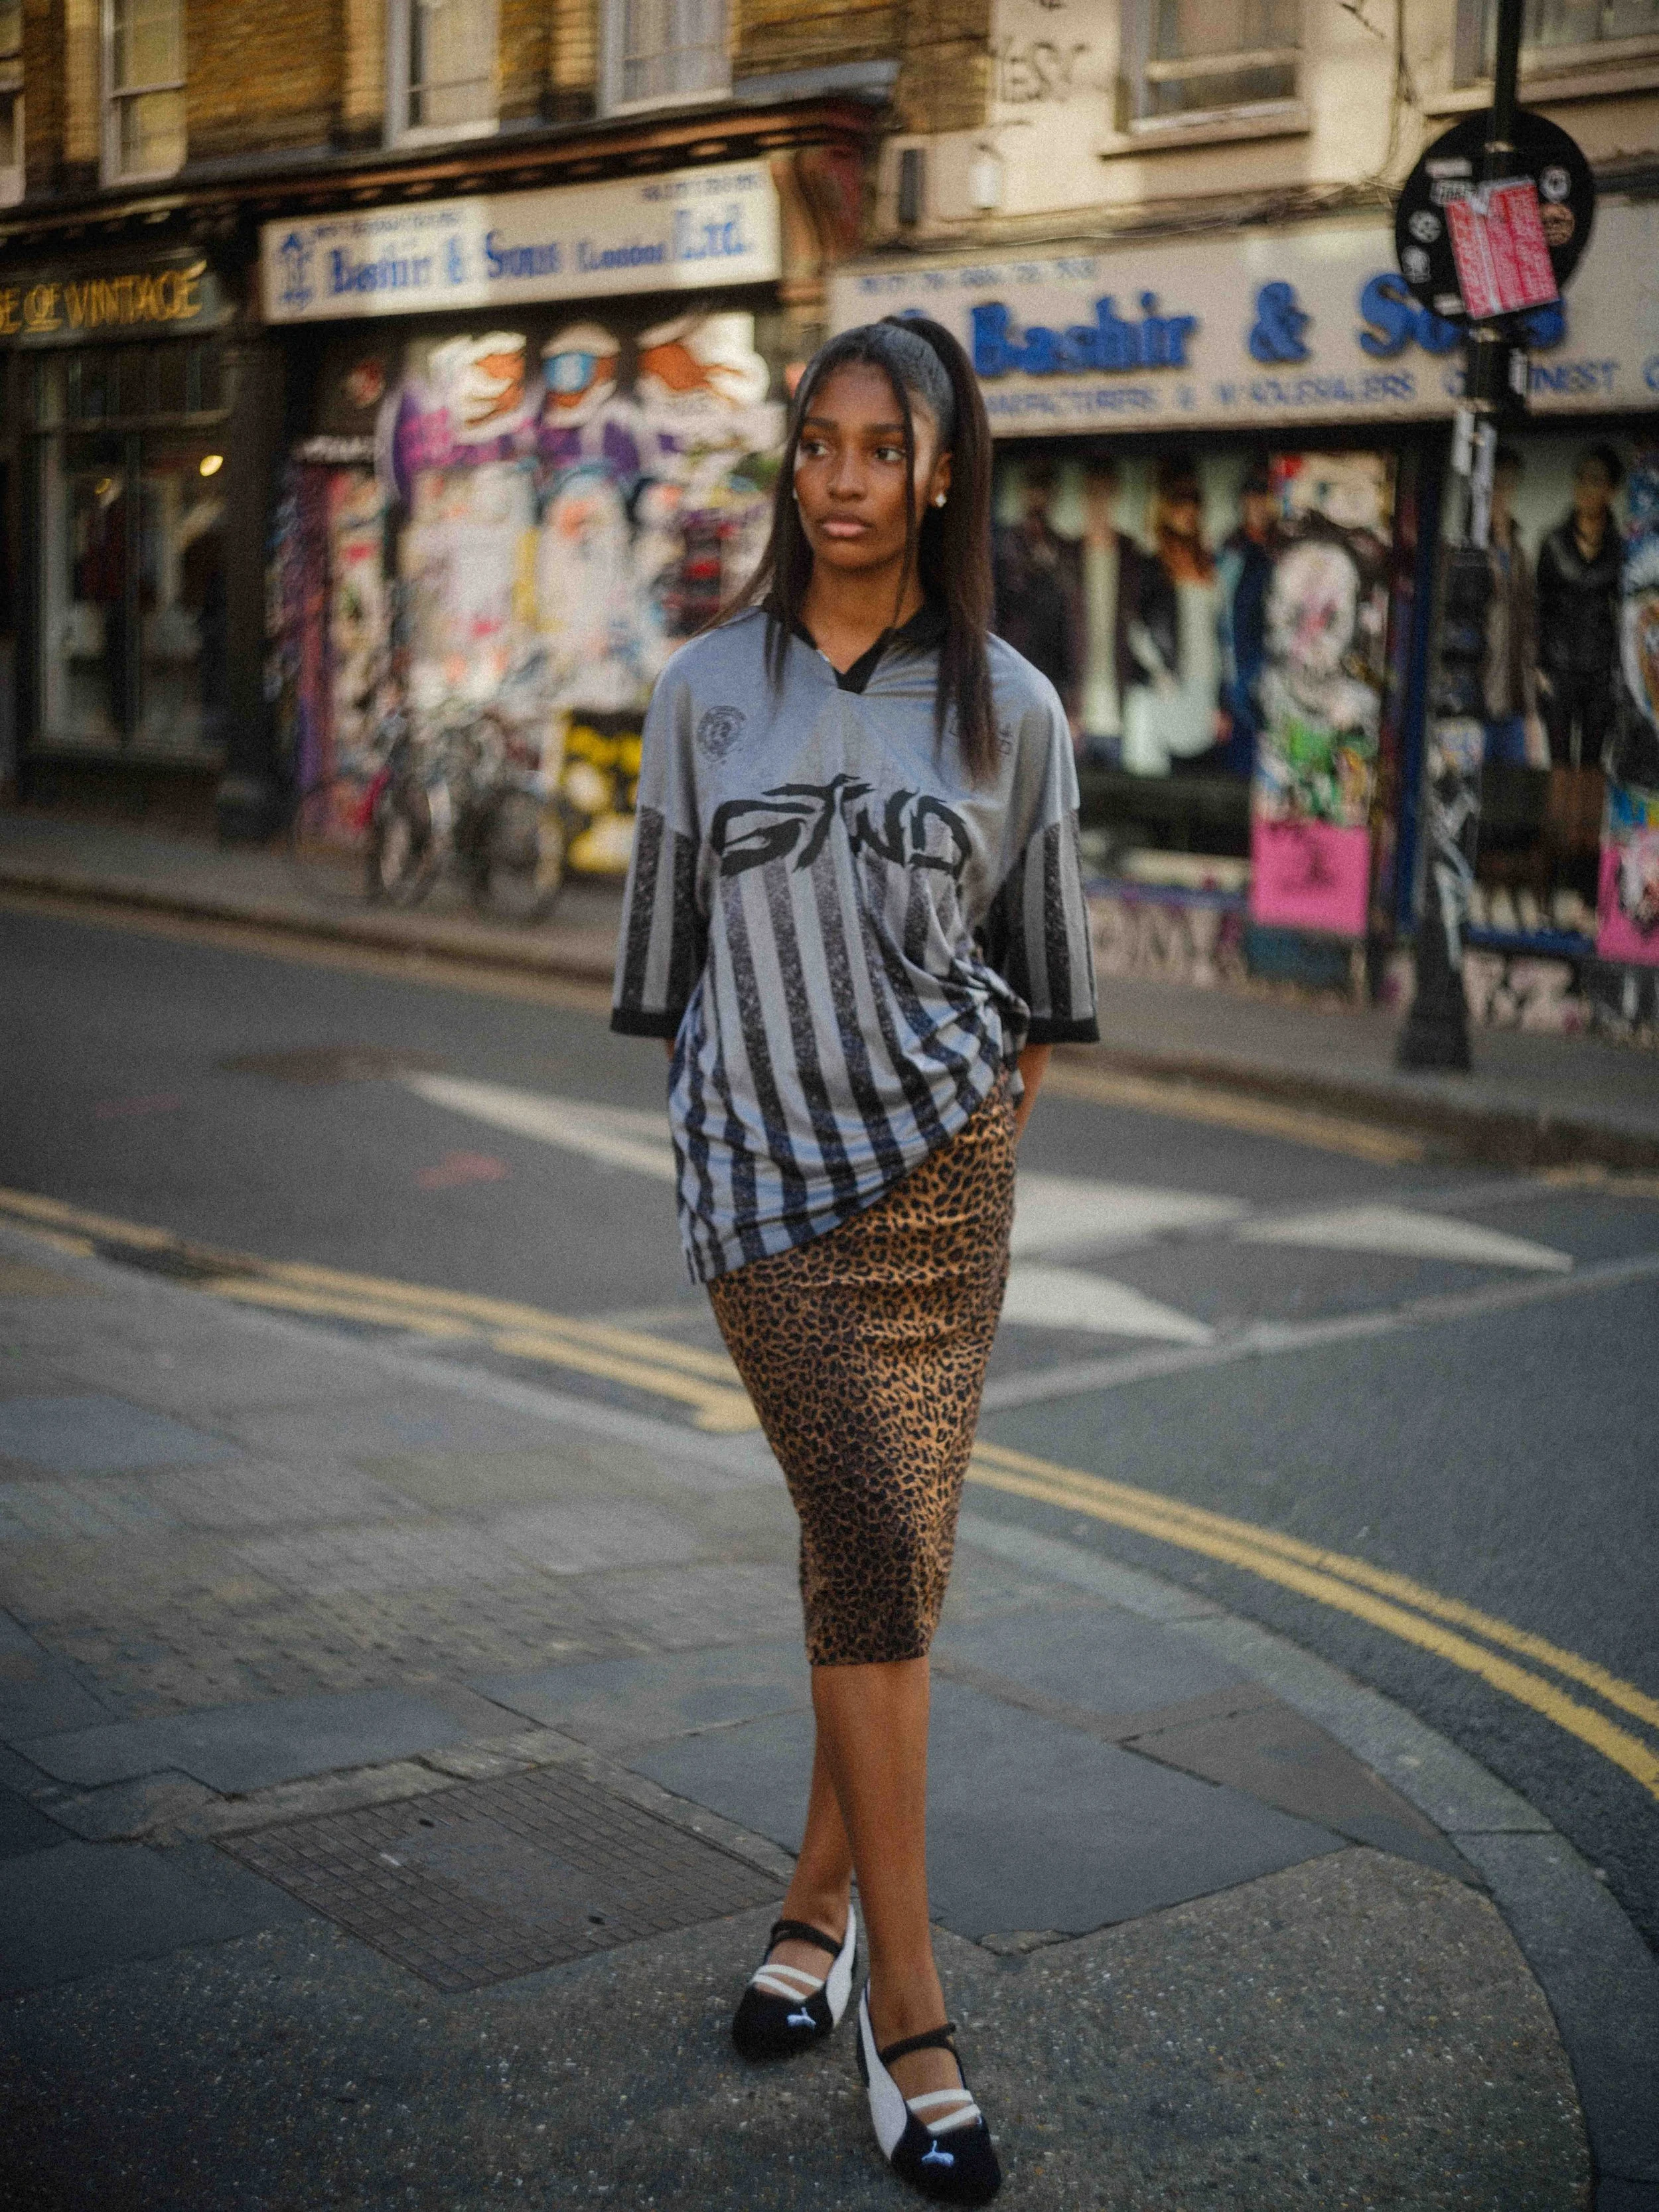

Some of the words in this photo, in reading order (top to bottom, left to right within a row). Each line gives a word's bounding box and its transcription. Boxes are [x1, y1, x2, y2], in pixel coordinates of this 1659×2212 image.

[64, 260, 207, 330] VINTAGE
[971, 290, 1196, 377] Bashir
[1249, 281, 1311, 364] &
[1528, 360, 1619, 394] NEST
